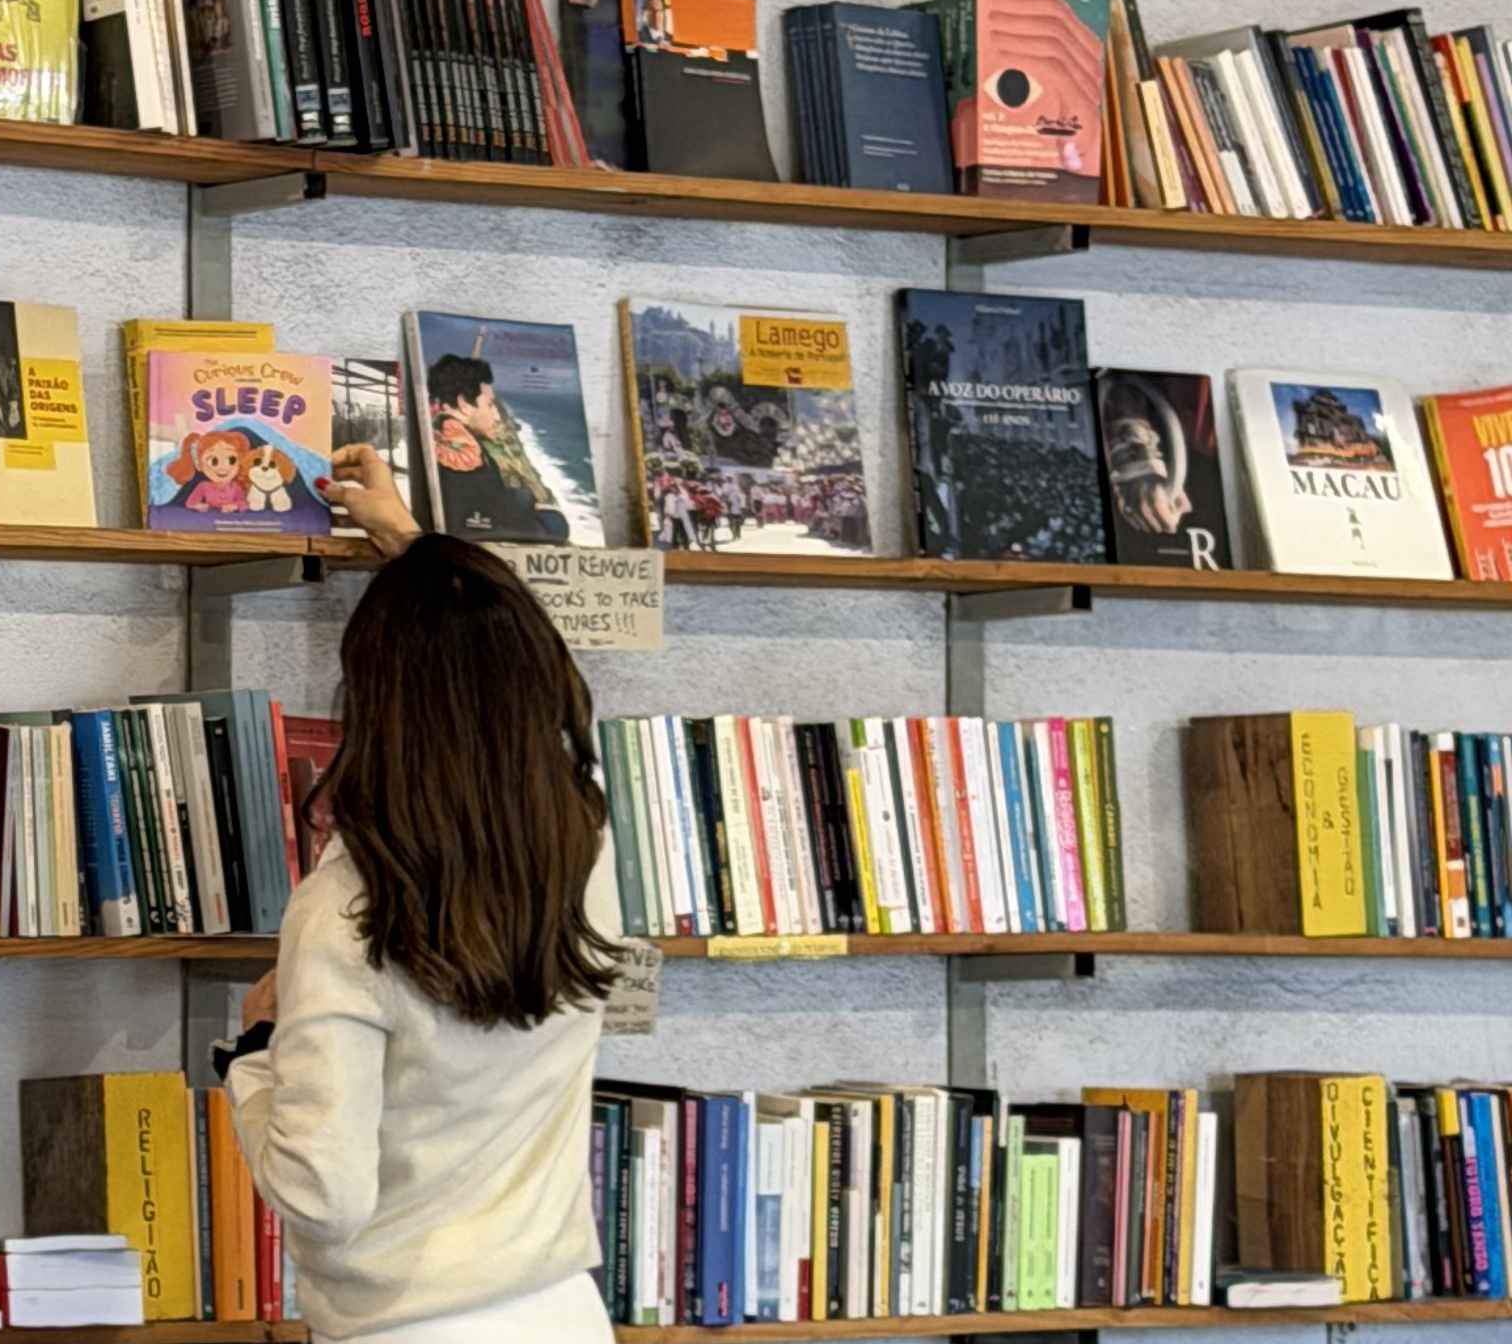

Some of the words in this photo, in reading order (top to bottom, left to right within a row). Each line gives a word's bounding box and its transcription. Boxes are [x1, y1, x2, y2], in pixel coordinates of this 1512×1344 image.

[755, 321, 839, 352] Lamego
[193, 363, 255, 385] Curious
[259, 362, 303, 386] Crew
[30, 390, 51, 401] DAS
[191, 386, 307, 425] SLEEP
[975, 385, 1000, 400] DO
[1001, 384, 1081, 404] OPERÁRIO
[30, 400, 78, 415] ORIGENS
[1290, 470, 1401, 502] MACAU
[1188, 528, 1219, 572] R
[526, 554, 572, 575] NOT
[578, 555, 651, 580] REMOVE
[594, 592, 613, 607] TO
[619, 591, 659, 607] TAKE
[139, 1108, 161, 1299] RELIGIÃO
